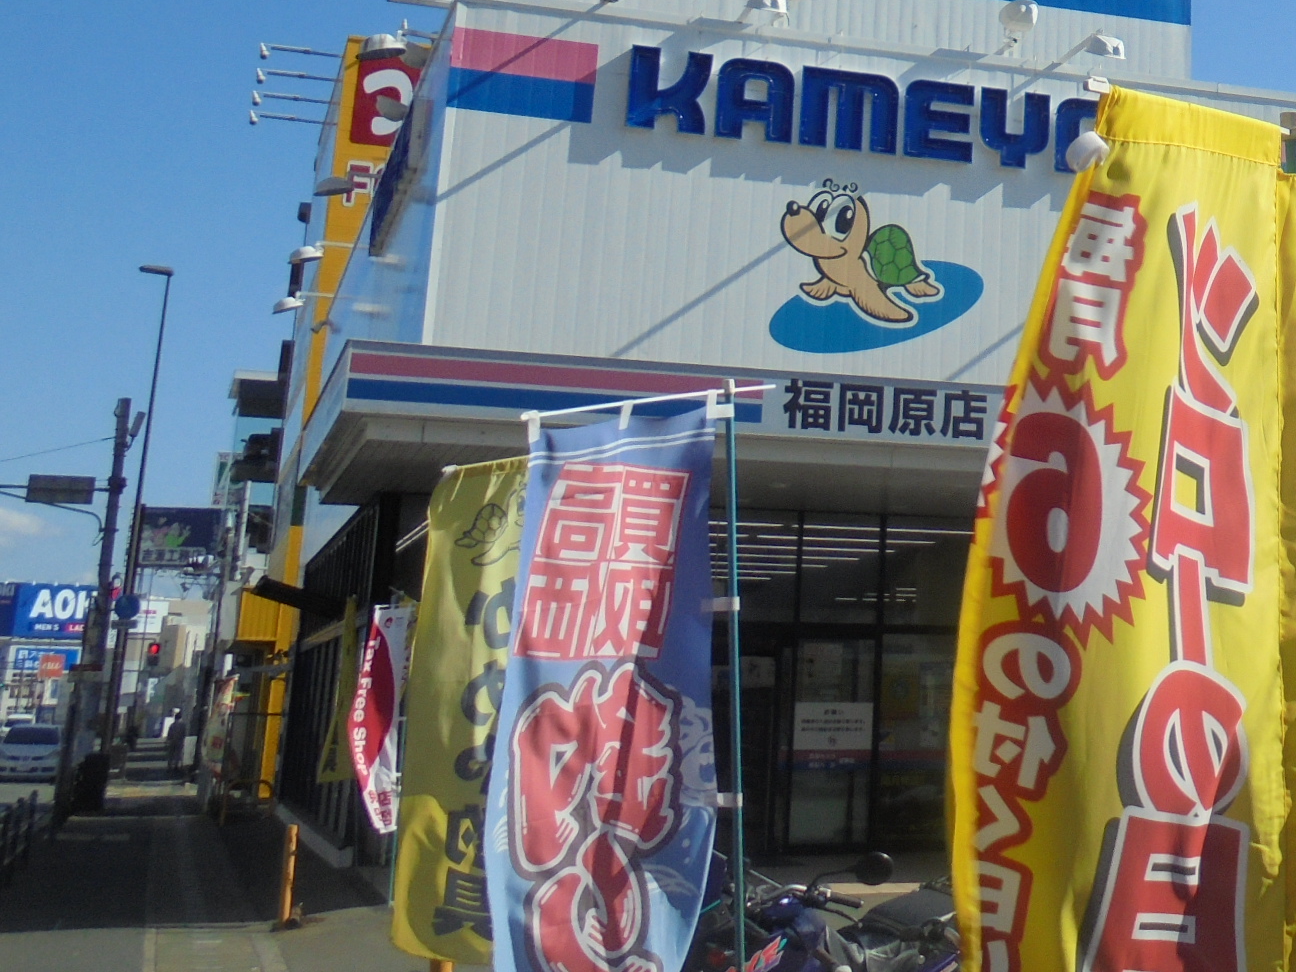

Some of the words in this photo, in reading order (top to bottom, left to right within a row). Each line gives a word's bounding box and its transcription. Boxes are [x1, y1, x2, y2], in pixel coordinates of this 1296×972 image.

[784, 380, 988, 440] 福岡原店
[363, 635, 381, 673] Tax
[354, 678, 372, 722] Free
[353, 727, 368, 776] Shop
